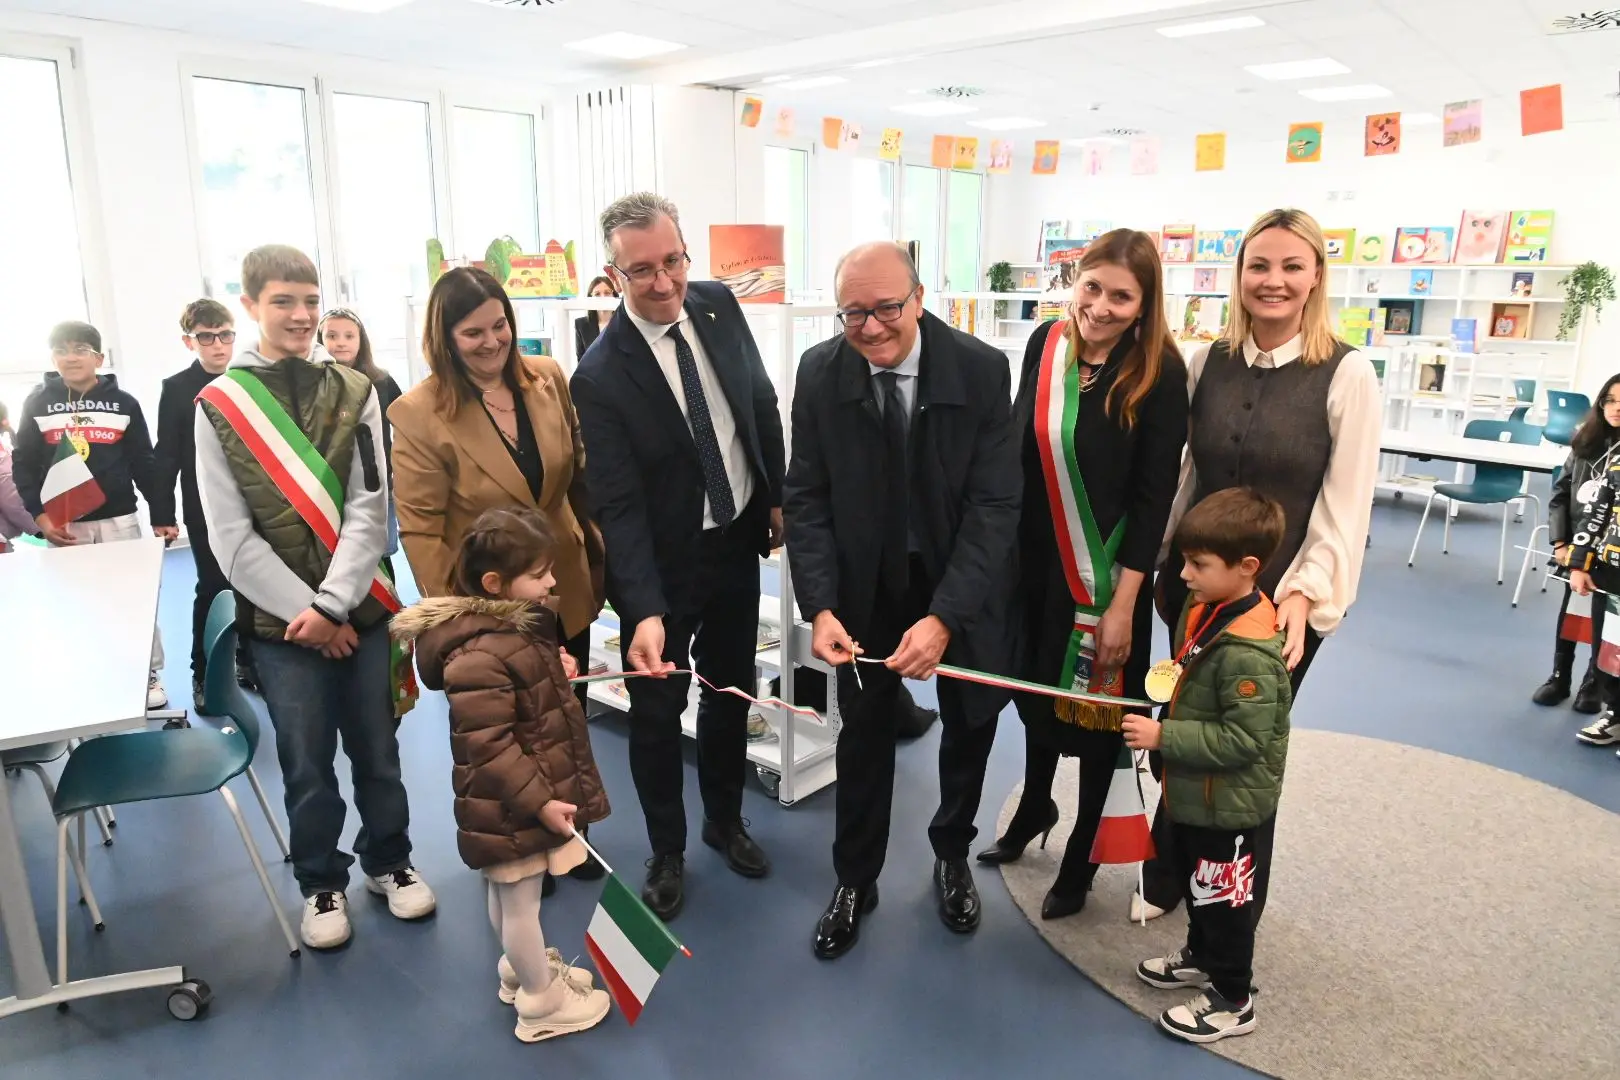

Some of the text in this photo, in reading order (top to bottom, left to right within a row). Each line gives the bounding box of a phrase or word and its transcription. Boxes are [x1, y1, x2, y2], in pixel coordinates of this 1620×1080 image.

[47, 400, 120, 413] LONSDALE
[54, 430, 116, 441] SICE 1960
